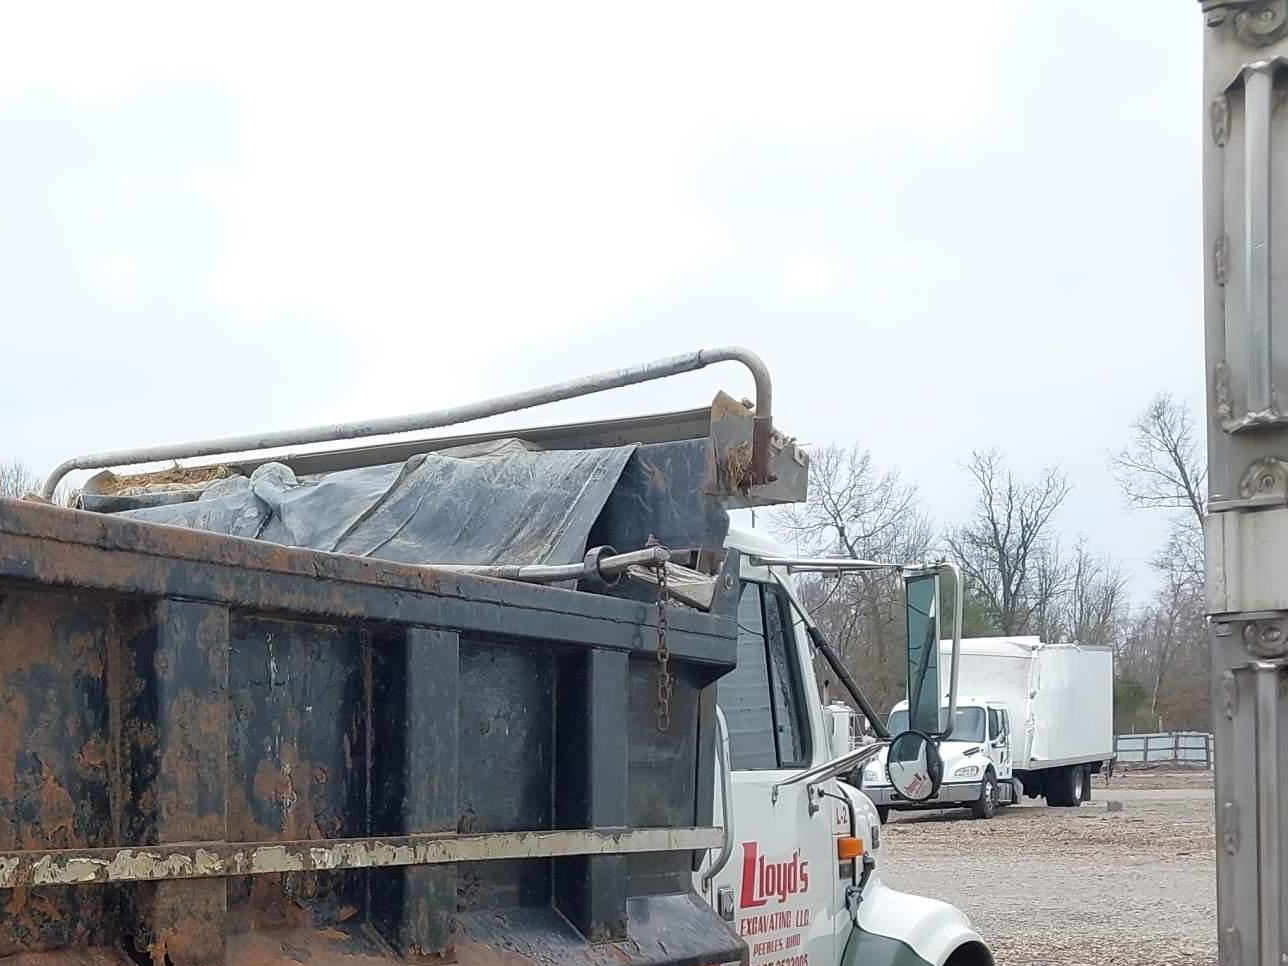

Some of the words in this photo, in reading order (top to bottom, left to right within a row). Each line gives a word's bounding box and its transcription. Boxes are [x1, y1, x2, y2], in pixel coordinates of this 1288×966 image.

[740, 841, 809, 908] Lloyd's
[740, 910, 792, 937] EXCAVATING
[796, 909, 810, 928] LLC
